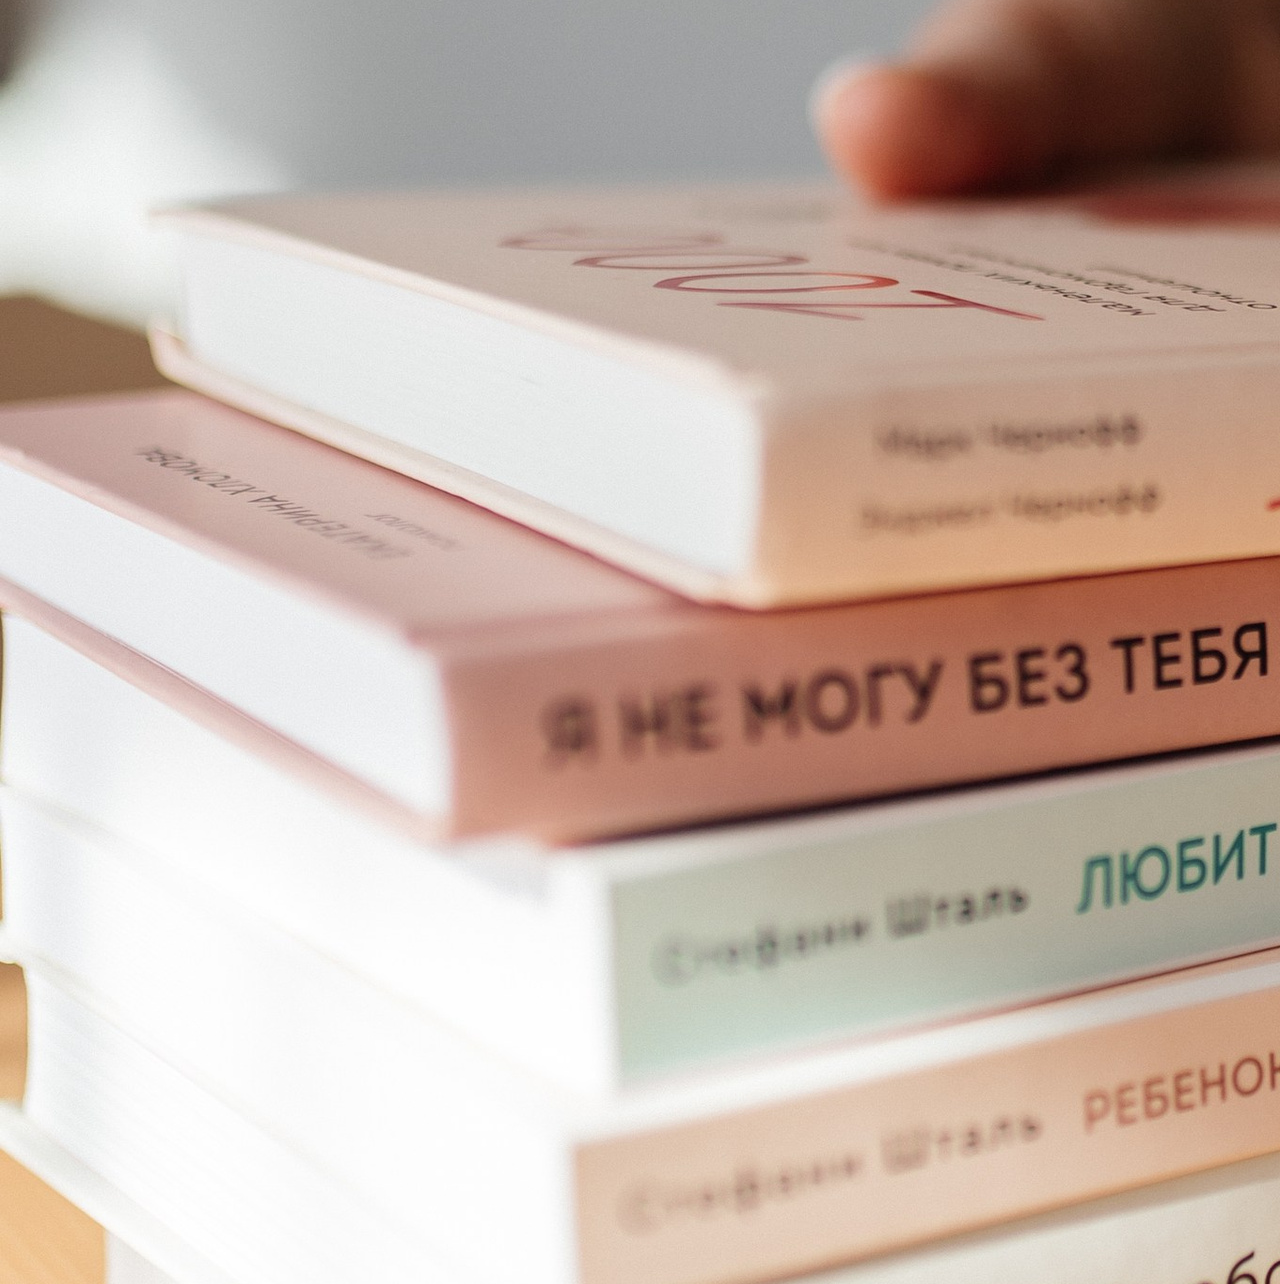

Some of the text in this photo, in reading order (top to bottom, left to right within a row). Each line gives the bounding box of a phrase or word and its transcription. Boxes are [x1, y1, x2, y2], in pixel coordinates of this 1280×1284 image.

[617, 679, 718, 763] НЕ
[739, 657, 943, 746] МОГУ
[968, 642, 1091, 714] БЕЗ
[1110, 621, 1270, 696] ТЕБЯ
[1076, 822, 1278, 915] ЛЮБИТ
